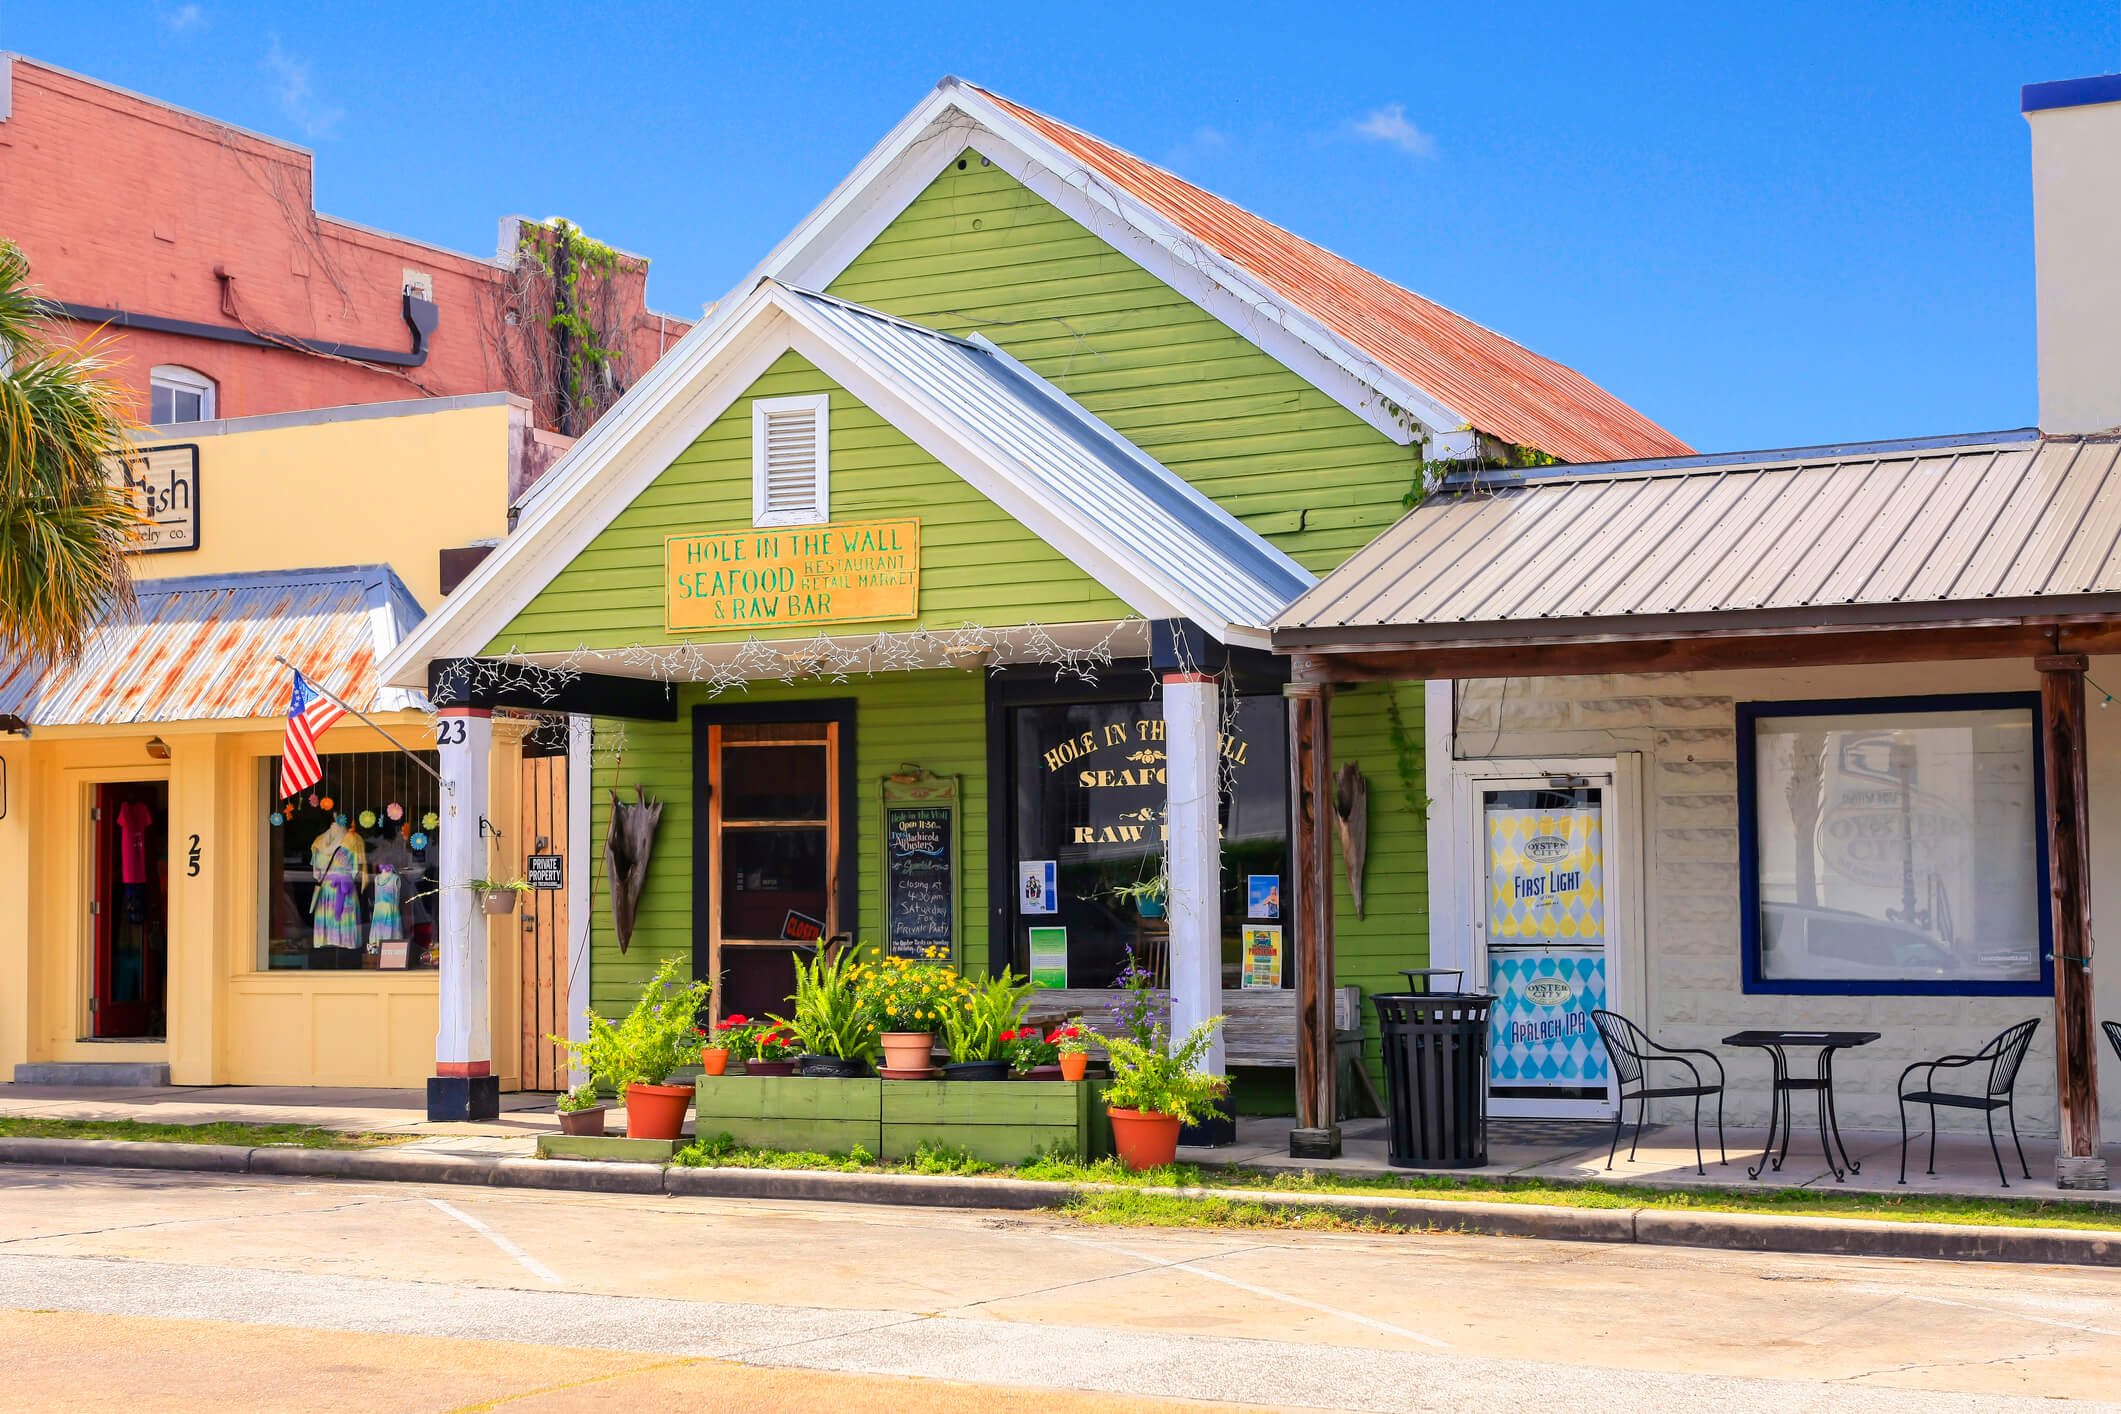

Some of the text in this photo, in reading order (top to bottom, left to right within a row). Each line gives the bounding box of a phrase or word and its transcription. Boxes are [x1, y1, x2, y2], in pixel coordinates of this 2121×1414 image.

[169, 528, 187, 540] co.
[687, 528, 902, 564] HOLE IN THE WALL
[803, 555, 904, 574] RESTAURANT
[678, 566, 794, 599] SEAFOOD
[801, 571, 914, 591] RETAIL MARKET
[714, 593, 831, 619] & RAW BAR
[436, 719, 467, 745] 23
[1043, 730, 1098, 772] HOLE
[1104, 722, 1128, 747] IN
[1136, 720, 1166, 741] TH
[1137, 807, 1157, 821] &
[898, 820, 917, 831] Open
[1073, 825, 1144, 844] RAW
[1527, 841, 1567, 850] OYSTER
[187, 834, 202, 878] 25
[532, 858, 557, 870] PRIVATE
[528, 870, 561, 881] PROPERTY
[1514, 870, 1580, 899] FIRST LIGHT
[1527, 983, 1568, 993] OYSTER
[1532, 991, 1563, 999] CITY
[1511, 1010, 1586, 1044] APALACH IPA
